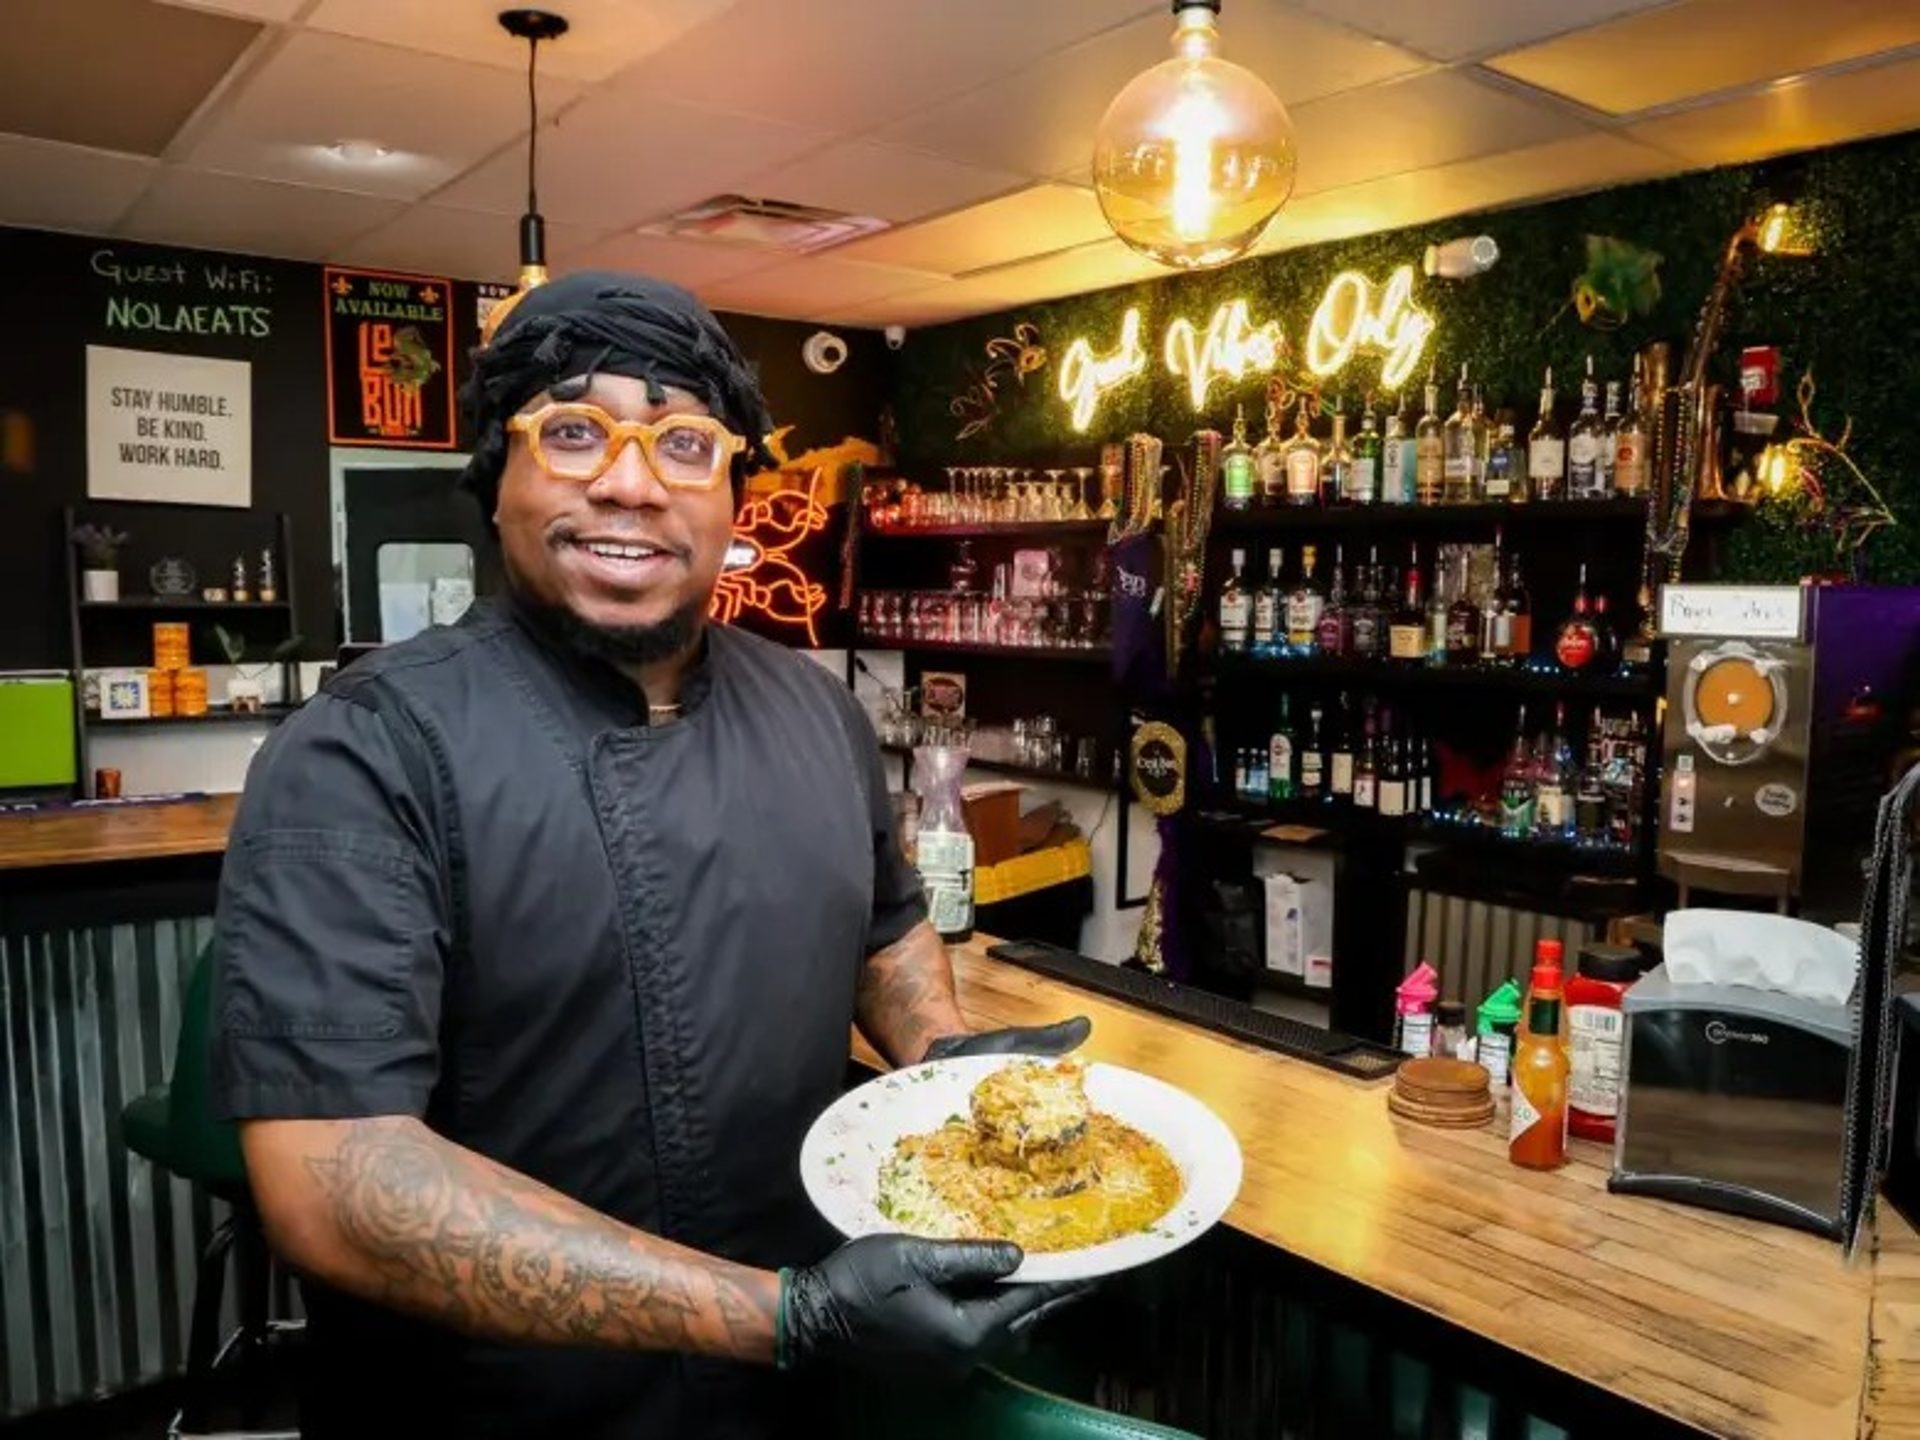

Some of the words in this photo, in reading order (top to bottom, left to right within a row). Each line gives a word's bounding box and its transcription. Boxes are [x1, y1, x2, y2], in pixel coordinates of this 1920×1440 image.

[368, 280, 411, 300] NOW
[107, 297, 271, 338] NOLAEATS
[335, 298, 444, 322] AVAILABLE
[1306, 265, 1437, 391] Only
[110, 386, 153, 411] STAY
[157, 390, 232, 418] HUMBLE.
[137, 415, 159, 438] BE
[163, 418, 208, 442] KIND.
[119, 442, 170, 467] WORK
[173, 447, 225, 471] HARD.
